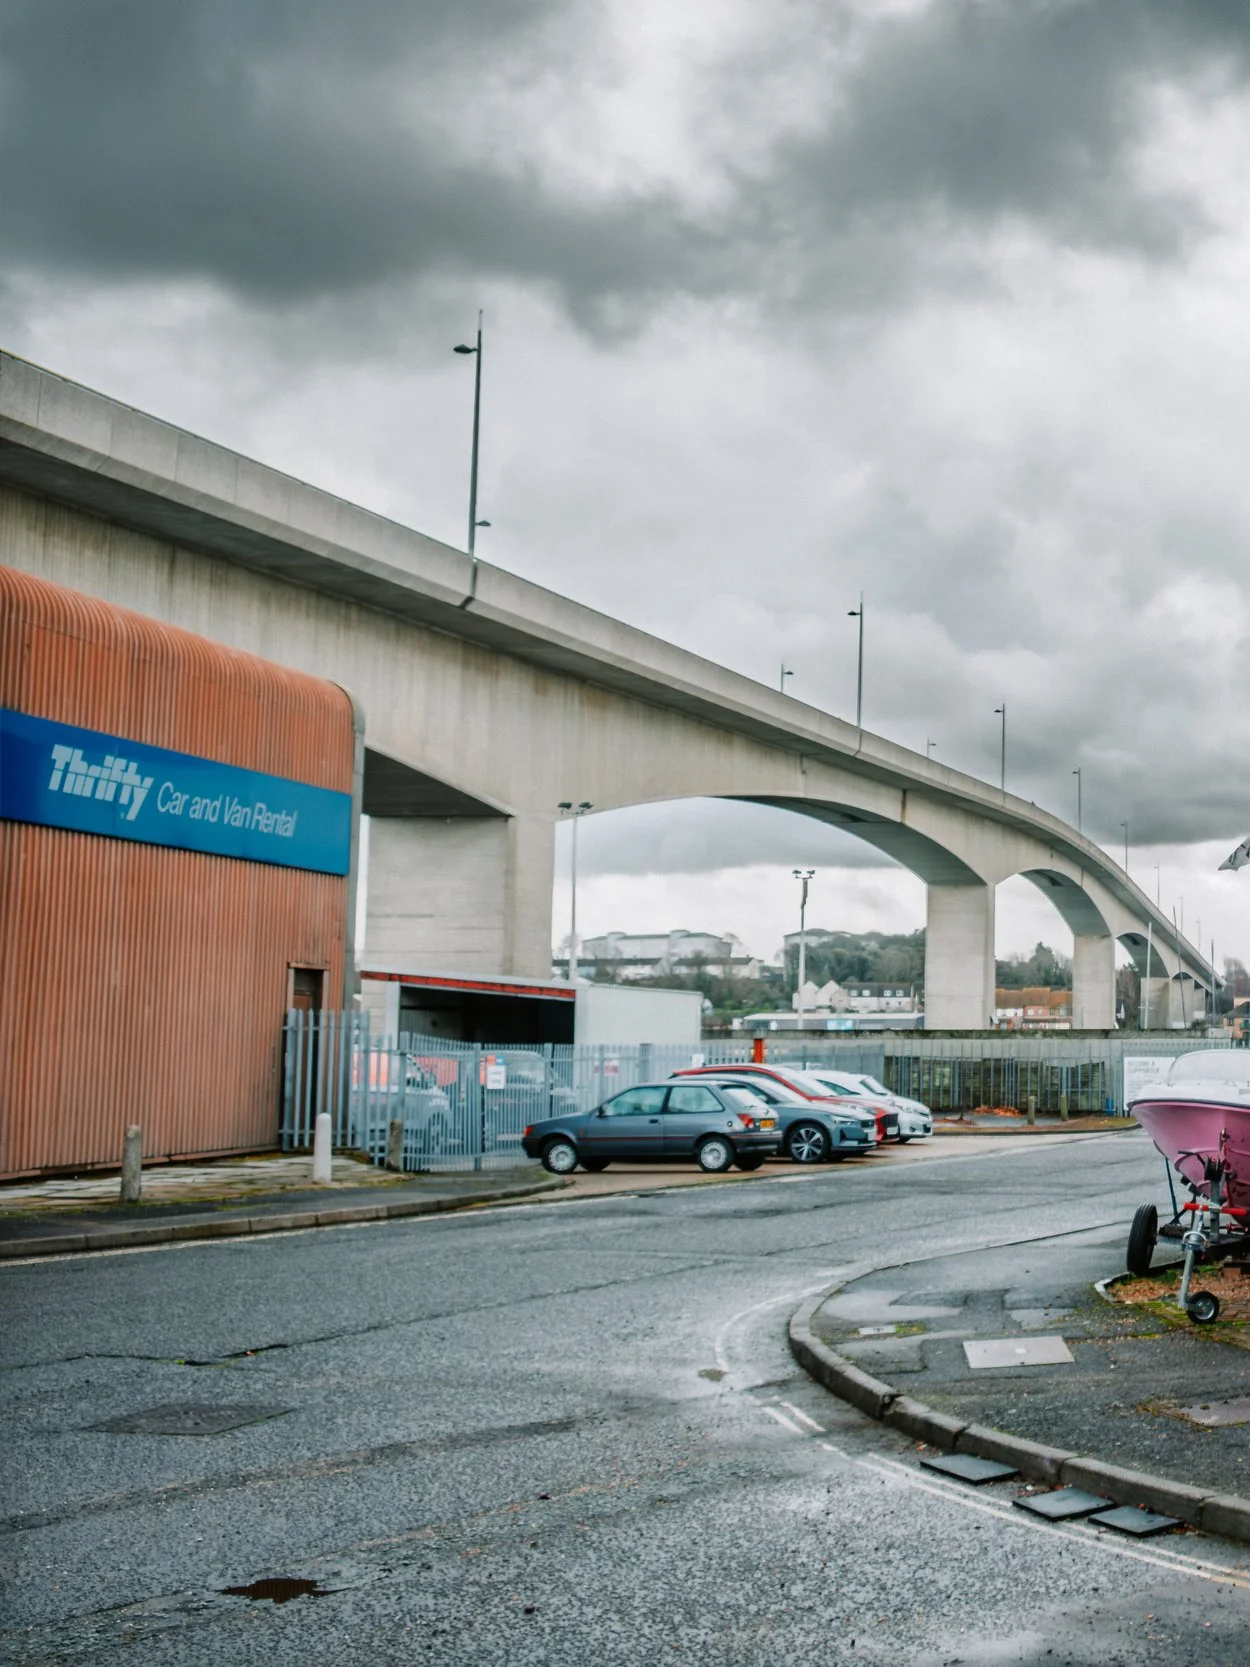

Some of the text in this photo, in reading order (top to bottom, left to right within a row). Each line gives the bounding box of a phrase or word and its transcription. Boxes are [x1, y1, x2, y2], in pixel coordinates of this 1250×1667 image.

[48, 744, 298, 837] Thrifty Car and Van Rental
